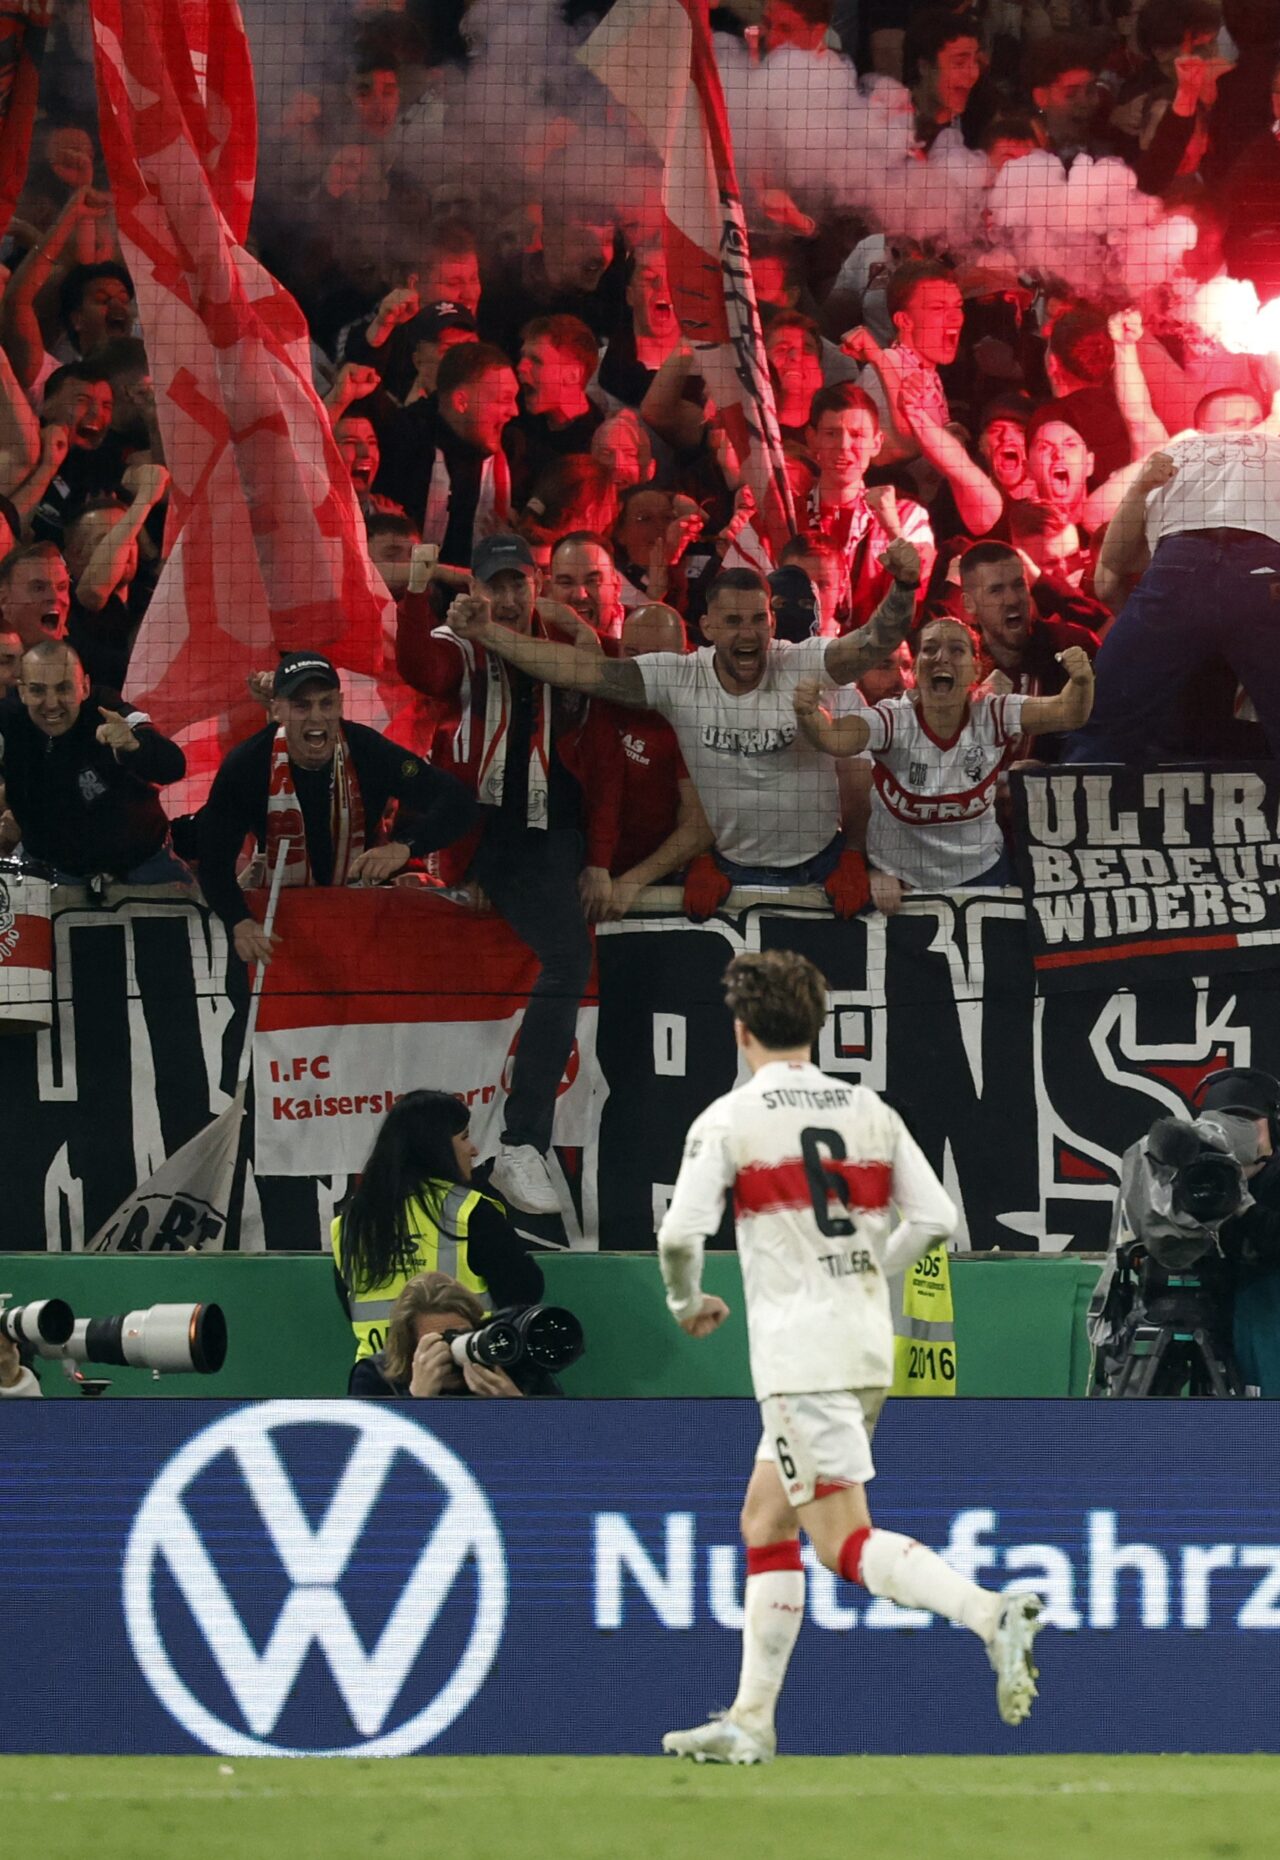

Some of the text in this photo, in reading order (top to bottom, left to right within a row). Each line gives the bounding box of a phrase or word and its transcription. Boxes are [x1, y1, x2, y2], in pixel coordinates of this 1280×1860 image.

[701, 722, 797, 755] ULTRAS
[883, 778, 998, 821] ULTRAS
[273, 1085, 497, 1120] Kaiserslrn
[800, 1126, 856, 1237] 6
[908, 1346, 955, 1380] 2016
[776, 1437, 797, 1479] 6
